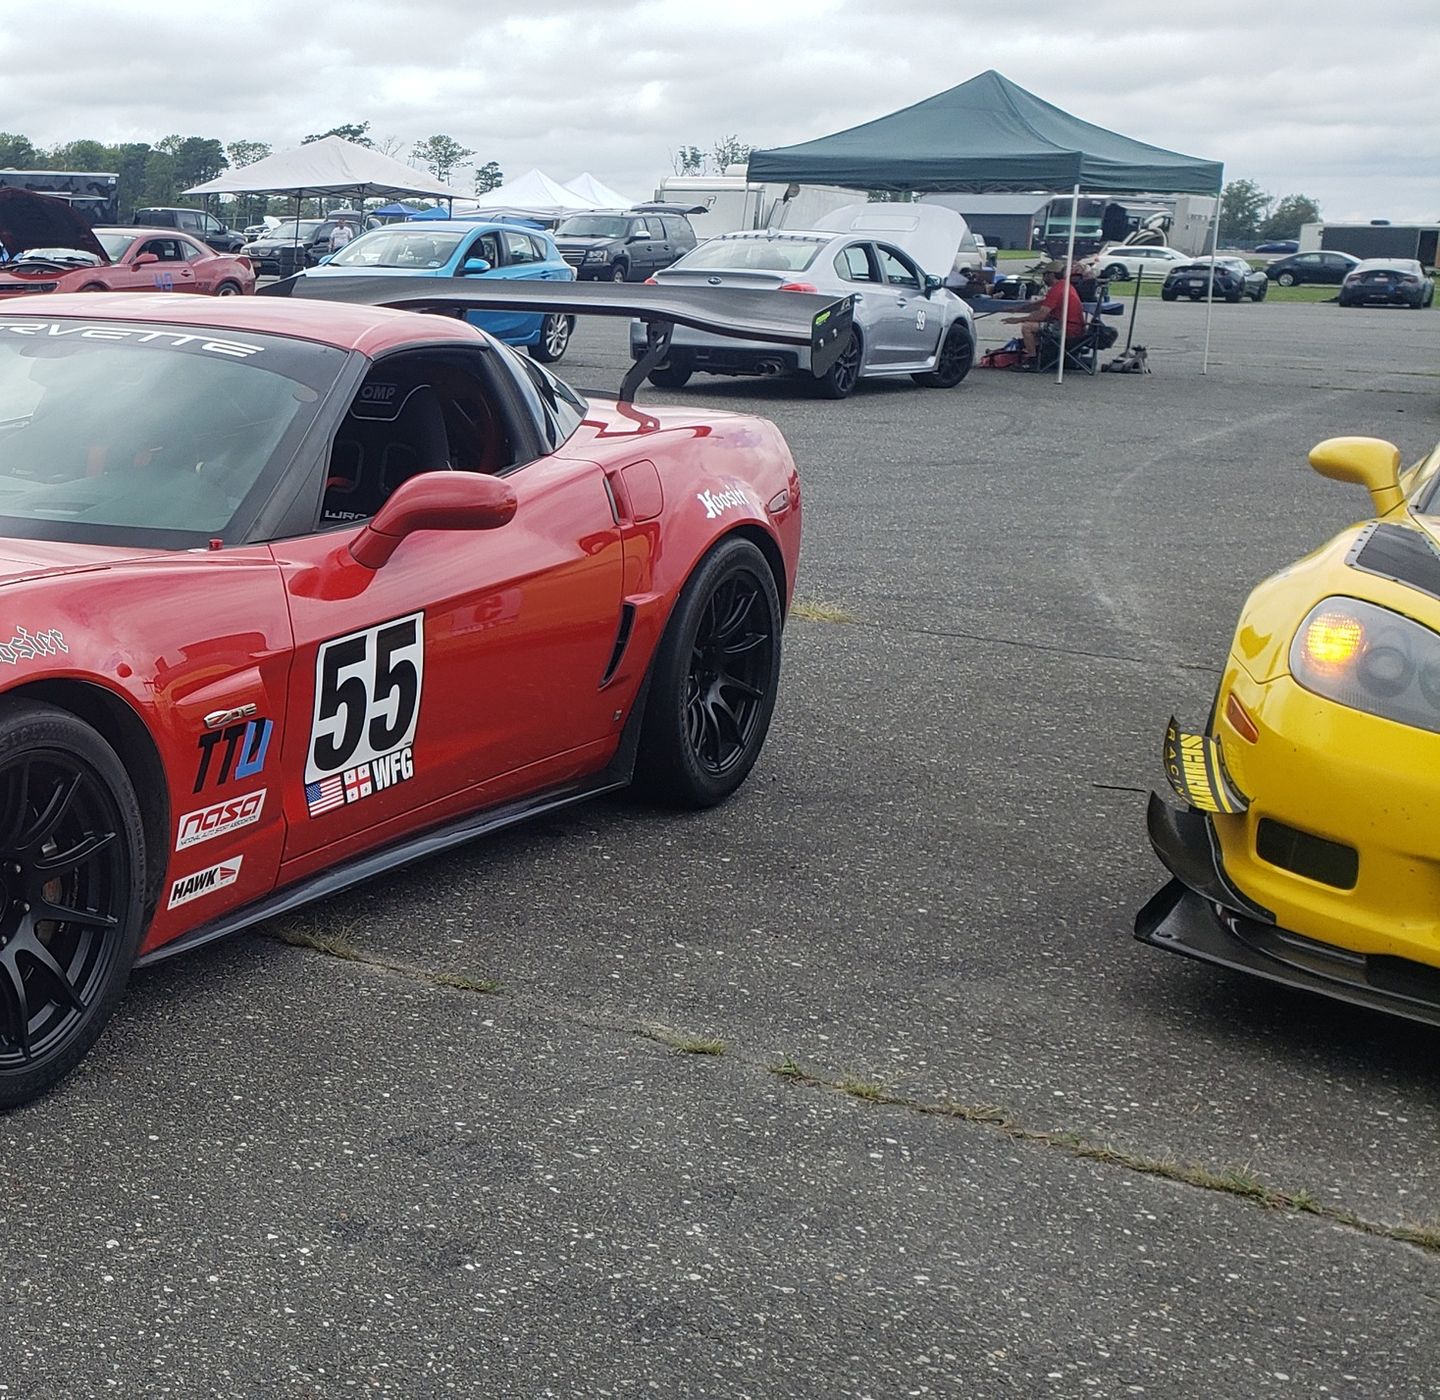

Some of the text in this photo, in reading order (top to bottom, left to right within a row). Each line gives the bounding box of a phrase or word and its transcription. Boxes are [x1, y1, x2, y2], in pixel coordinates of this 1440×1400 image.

[362, 385, 396, 400] OMP
[313, 618, 418, 772] 55
[191, 716, 274, 795] TTU
[372, 748, 414, 792] WFG
[180, 793, 263, 839] nasa
[171, 867, 219, 902] HAWK
